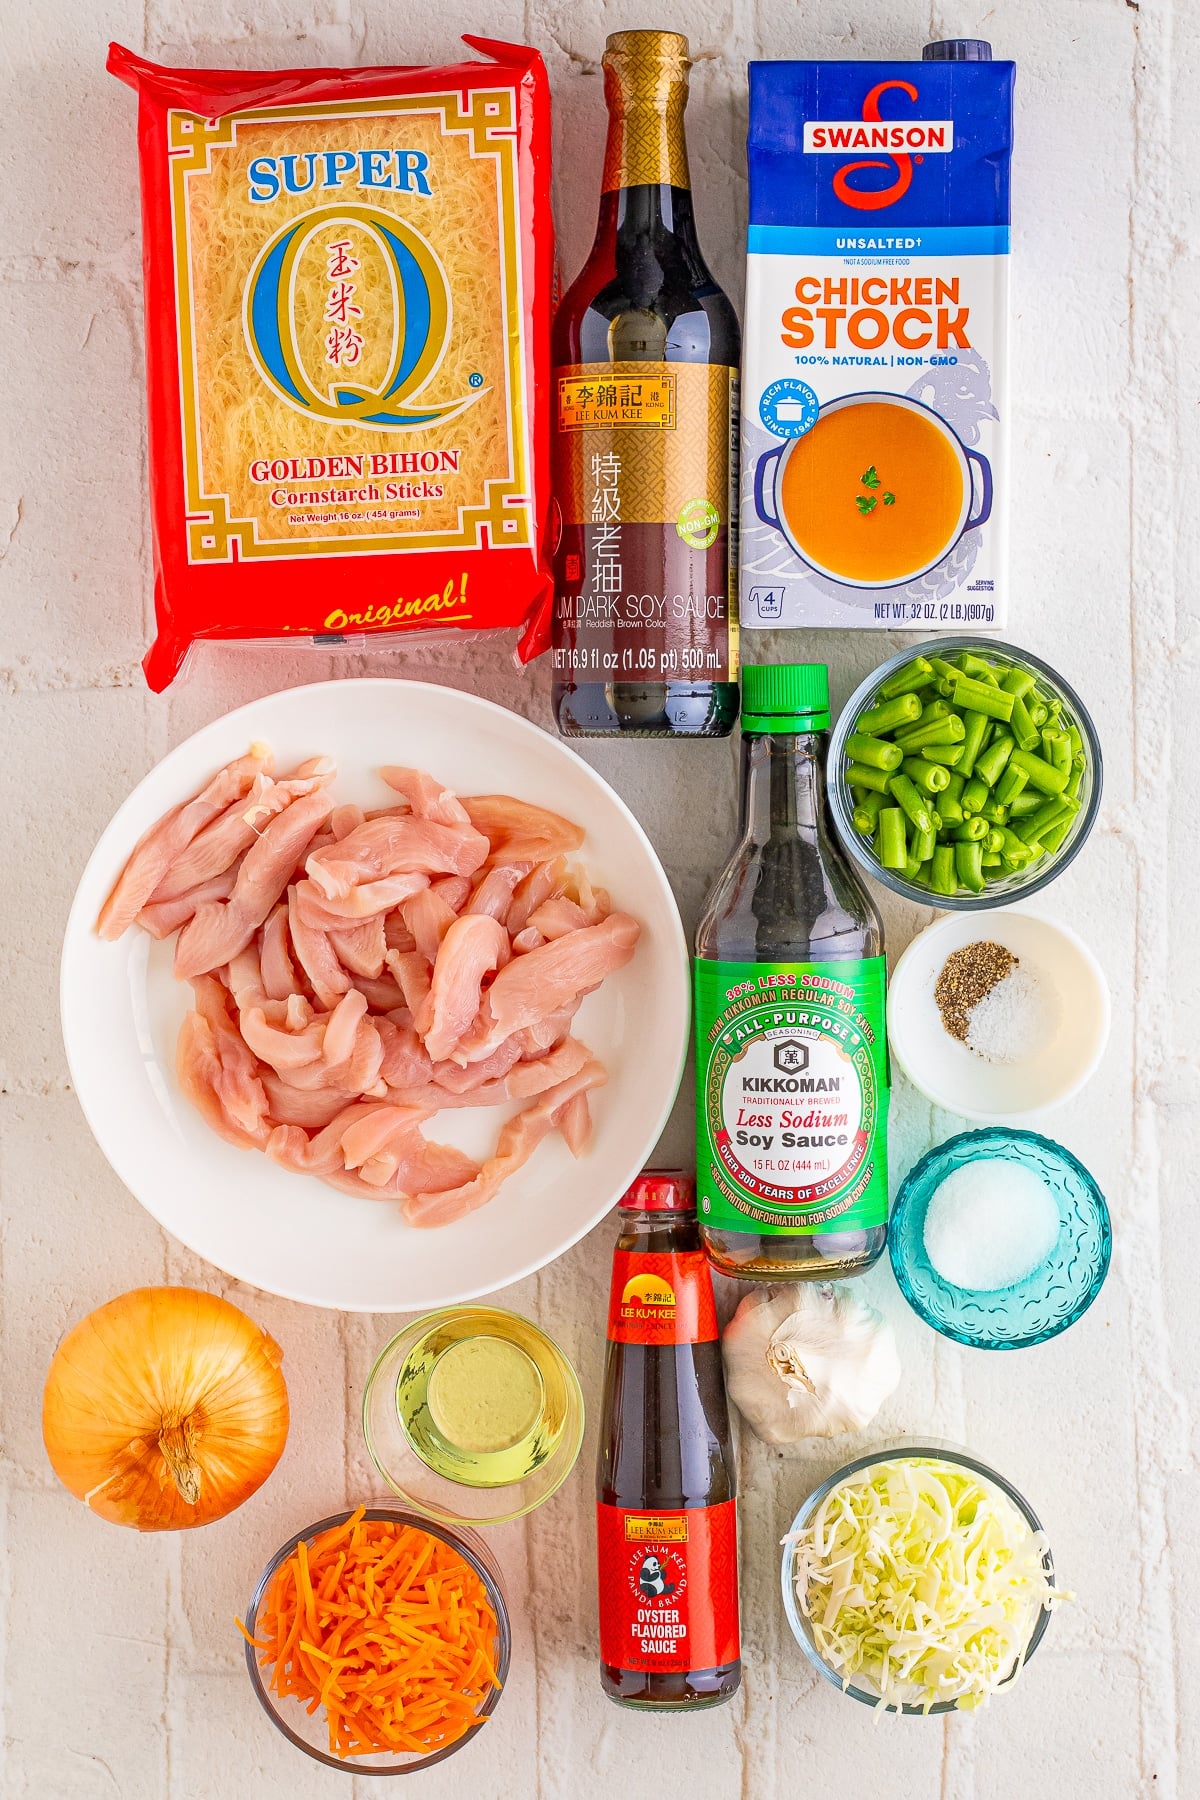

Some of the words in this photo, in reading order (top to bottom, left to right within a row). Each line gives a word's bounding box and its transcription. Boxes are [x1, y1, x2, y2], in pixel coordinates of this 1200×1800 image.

[812, 127, 945, 148] SWANSON
[249, 150, 431, 203] SUPER
[795, 276, 960, 305] CHICKEN
[328, 242, 362, 363] 玉米粉
[243, 203, 492, 430] Q
[781, 307, 972, 350] STOCK
[795, 355, 830, 366] 100%
[833, 356, 887, 366] NATURAL
[897, 356, 958, 366] NON-GMO
[576, 385, 642, 409] 李錦記
[763, 384, 781, 405] RICH
[784, 382, 816, 406] FLAVOR
[576, 411, 590, 421] LEE
[593, 410, 618, 420] KUM
[622, 409, 643, 418] KEE
[763, 415, 790, 436] SINCE
[794, 416, 814, 434] 1945
[251, 456, 363, 481] GOLDEN
[371, 451, 459, 475] BIHON
[271, 485, 379, 505] Cornstarch
[386, 482, 443, 500] Sticks
[290, 514, 305, 523] Net
[307, 512, 337, 523] Weight
[340, 512, 350, 520] 16
[352, 512, 364, 520] oz.
[390, 509, 420, 520] grams)
[591, 451, 622, 593] 特級老抽
[679, 513, 718, 534] NON-GM
[324, 573, 469, 630] Original!
[576, 595, 620, 618] DARK
[626, 594, 667, 618] SOY
[672, 595, 724, 619] SAUCE
[763, 591, 775, 605] 4
[874, 603, 890, 619] NET
[893, 604, 909, 619] WT.
[911, 604, 921, 619] 32
[924, 604, 937, 619] OZ.
[939, 603, 948, 621] (2
[586, 619, 615, 628] Reddish
[617, 619, 642, 628] Brown
[645, 619, 666, 628] Color
[568, 649, 587, 669] 16.9
[591, 648, 599, 669] fl
[603, 653, 618, 669] oz
[623, 648, 655, 670] (1.05
[660, 648, 678, 673] pt)
[682, 649, 703, 669] 500
[706, 650, 721, 668] mL
[726, 980, 755, 1001] 38%
[759, 974, 796, 989] LESS
[802, 974, 855, 1000] SODIUM
[707, 1017, 725, 1042] THAN
[724, 989, 777, 1020] KIKKOMAN
[781, 989, 835, 1006] REGULAR
[837, 999, 856, 1016] SOY
[855, 1012, 875, 1044] SAUCE
[766, 1028, 818, 1038] SEASONING
[742, 1077, 840, 1093] KIKKOMAN
[742, 1096, 805, 1106] TRADITIONALLY
[808, 1096, 840, 1105] BREWED
[736, 1108, 772, 1127] Less
[779, 1110, 848, 1129] Sodium
[736, 1130, 774, 1150] Soy
[782, 1132, 848, 1148] Sauce
[720, 1144, 739, 1173] OVER
[738, 1172, 755, 1188] 300
[758, 1183, 794, 1199] YEARS
[797, 1188, 812, 1199] OF
[815, 1145, 864, 1196] EXCELLENCE
[753, 1159, 762, 1170] 15
[765, 1159, 775, 1171] FL
[778, 1159, 790, 1171] OZ
[792, 1159, 811, 1173] (444
[813, 1159, 830, 1172] mL)
[718, 1180, 751, 1215] NUTRITION
[750, 1207, 807, 1227] INFORMATION
[808, 1213, 825, 1224] FOR
[825, 1198, 854, 1220] SODIUM
[852, 1168, 873, 1200] CONTENT
[621, 1308, 634, 1318] LEE
[636, 1308, 657, 1319] KUM
[658, 1309, 676, 1320] KEE
[646, 1527, 666, 1535] KUM
[630, 1550, 643, 1566] LEE
[645, 1545, 669, 1555] KUM
[671, 1551, 686, 1569] KEE
[628, 1575, 652, 1607] PANDA
[658, 1579, 687, 1608] BRAND
[637, 1609, 680, 1623] OYSTER
[631, 1624, 686, 1638] FLAVORED
[641, 1640, 677, 1653] SAUCE
